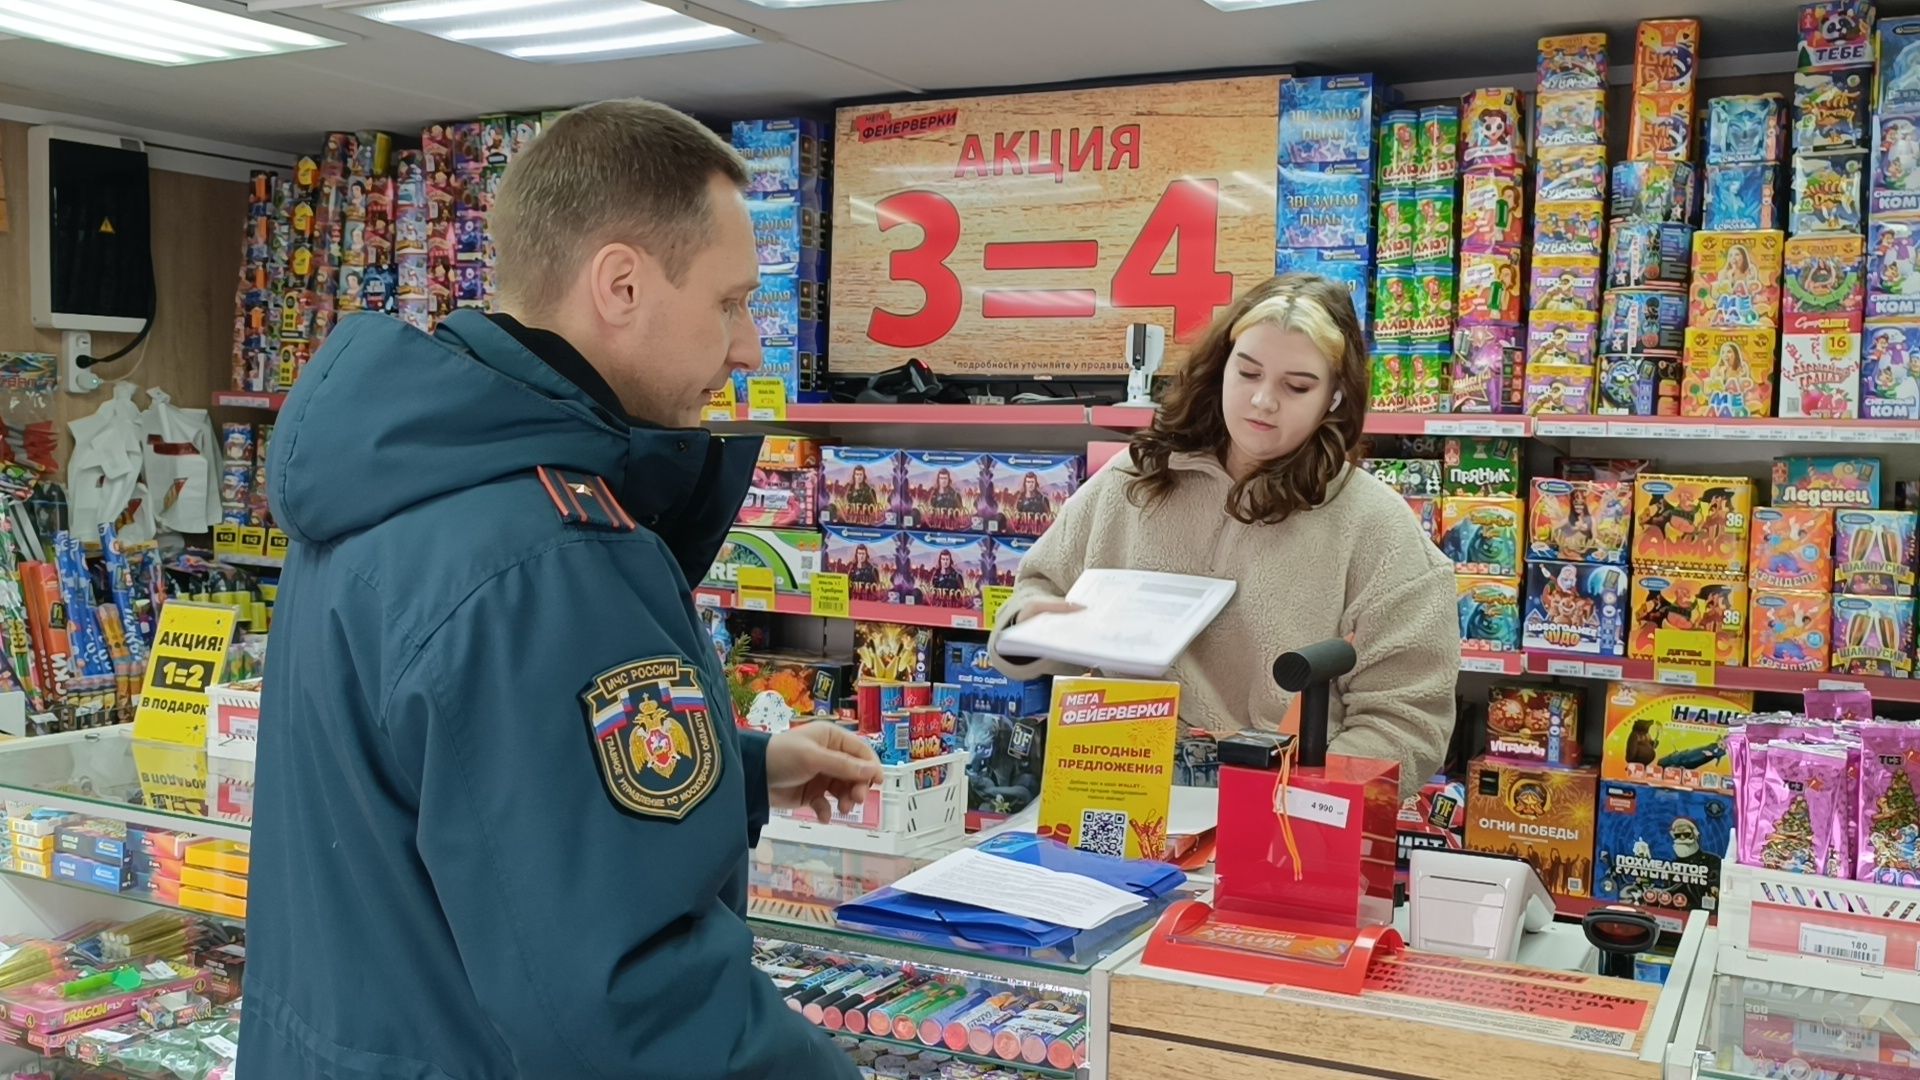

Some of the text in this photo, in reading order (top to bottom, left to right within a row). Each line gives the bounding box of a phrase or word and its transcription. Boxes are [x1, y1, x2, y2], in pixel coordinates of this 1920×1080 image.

[1815, 45, 1864, 61] ТЕБЕ
[862, 111, 958, 139] ФЕЙЕРВЕРКИ
[954, 124, 1142, 184] АКЦИЯ
[1879, 197, 1917, 210] КОМ
[867, 177, 1234, 349] 3=4
[1876, 302, 1914, 314] КОМ
[1829, 335, 1847, 348] 16
[1870, 405, 1908, 417] КОМ
[1374, 469, 1397, 485] 64
[1450, 467, 1511, 485] ПРЯНИК
[1783, 486, 1870, 506] Леденец
[1726, 512, 1744, 527] 36
[1723, 610, 1741, 624] 36
[159, 631, 224, 652] АКЦИЯ!
[1544, 631, 1581, 648] ЧУДО
[163, 662, 205, 688] 1=2
[606, 665, 674, 692] МЧС РОССИИ
[141, 697, 209, 716] В ПОДАРОК
[1066, 693, 1100, 707] МЕГА
[1062, 702, 1170, 724] ФЕЙЕРВЕРКИ
[1072, 744, 1151, 759] ВЫГОДНЫЕ
[1058, 759, 1164, 775] ПРЕДЛОЖЕНИЯ
[1311, 801, 1334, 814] 4 990
[1479, 816, 1579, 841] ОГНИ ПОБЕДЫ
[1616, 854, 1709, 875] ПОХМЕЛЯТОР
[1851, 940, 1868, 951] 180
[64, 1003, 108, 1024] DRAGON
